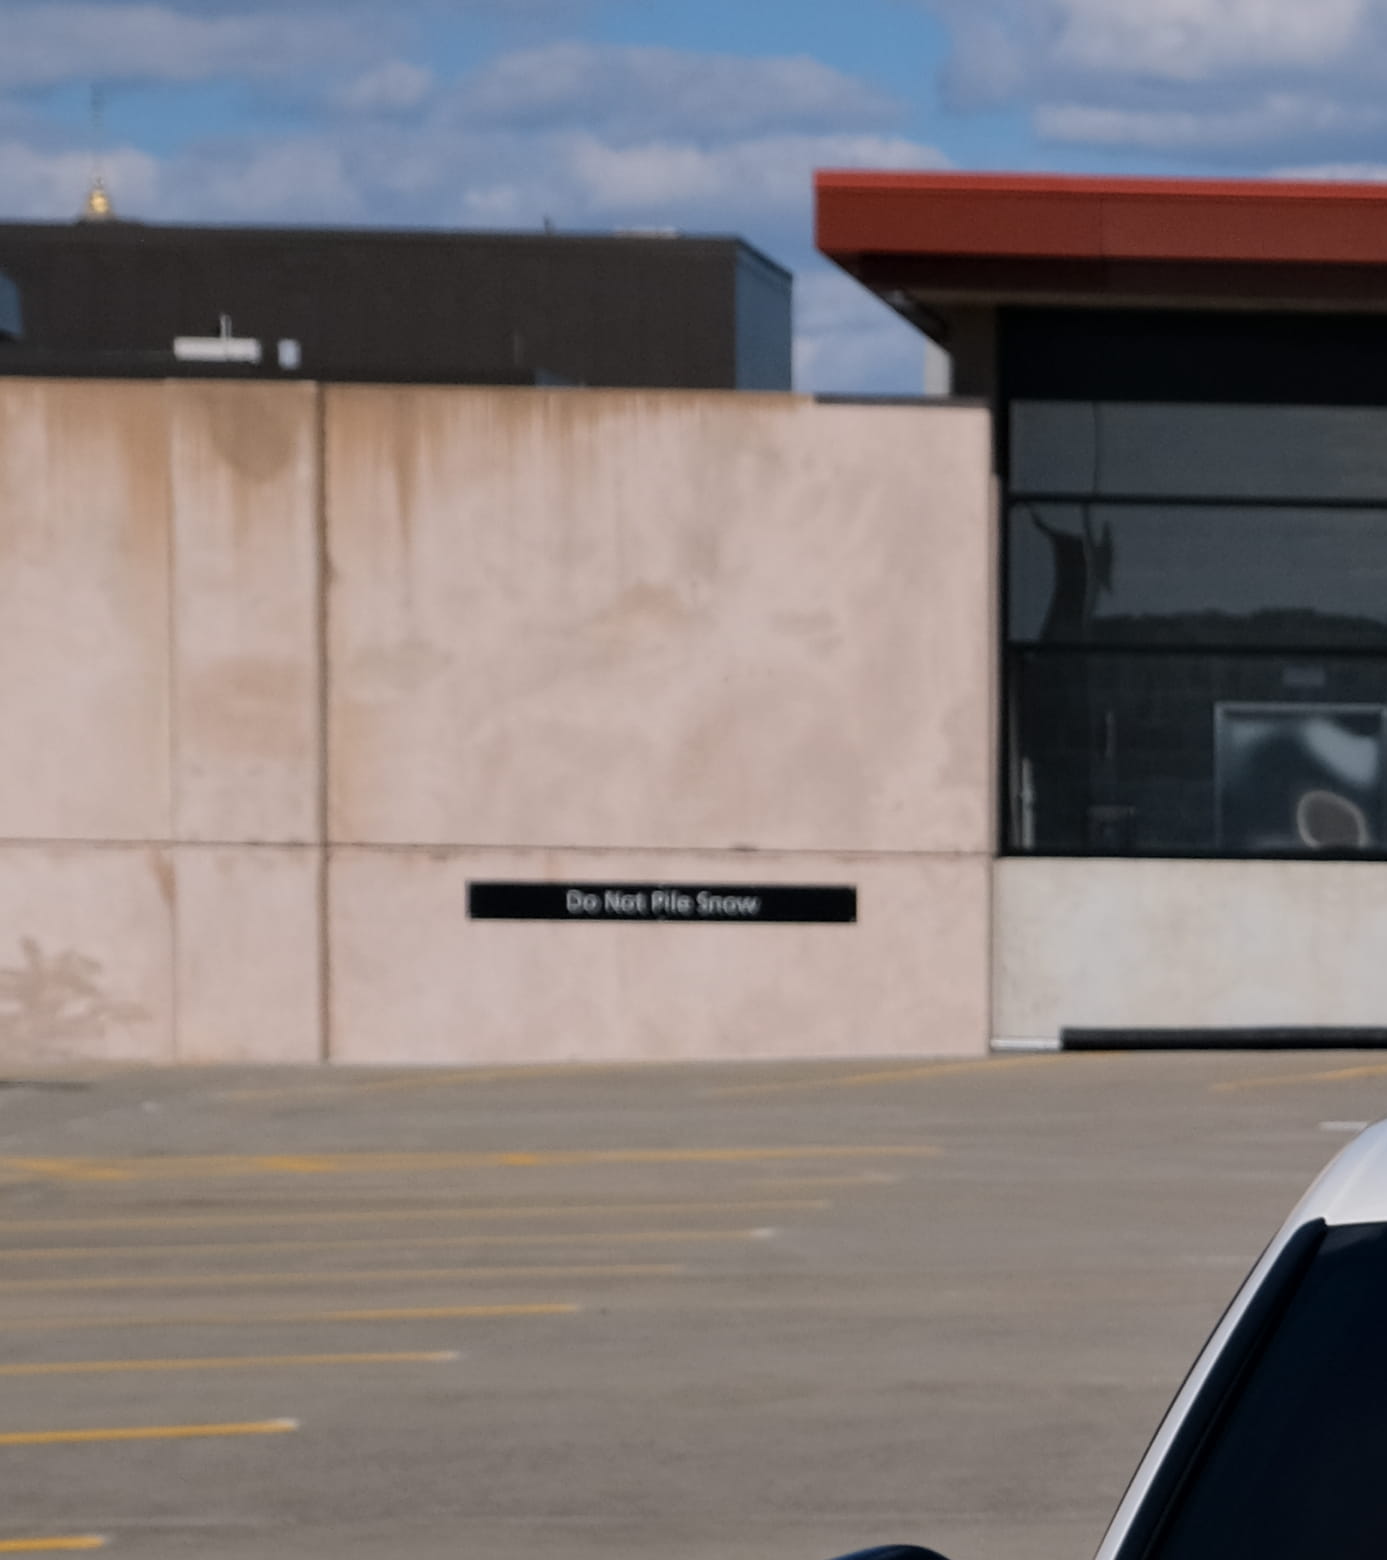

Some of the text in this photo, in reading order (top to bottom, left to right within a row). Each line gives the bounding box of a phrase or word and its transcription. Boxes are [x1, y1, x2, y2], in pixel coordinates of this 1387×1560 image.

[566, 889, 757, 915] Do Not Pile Snow
